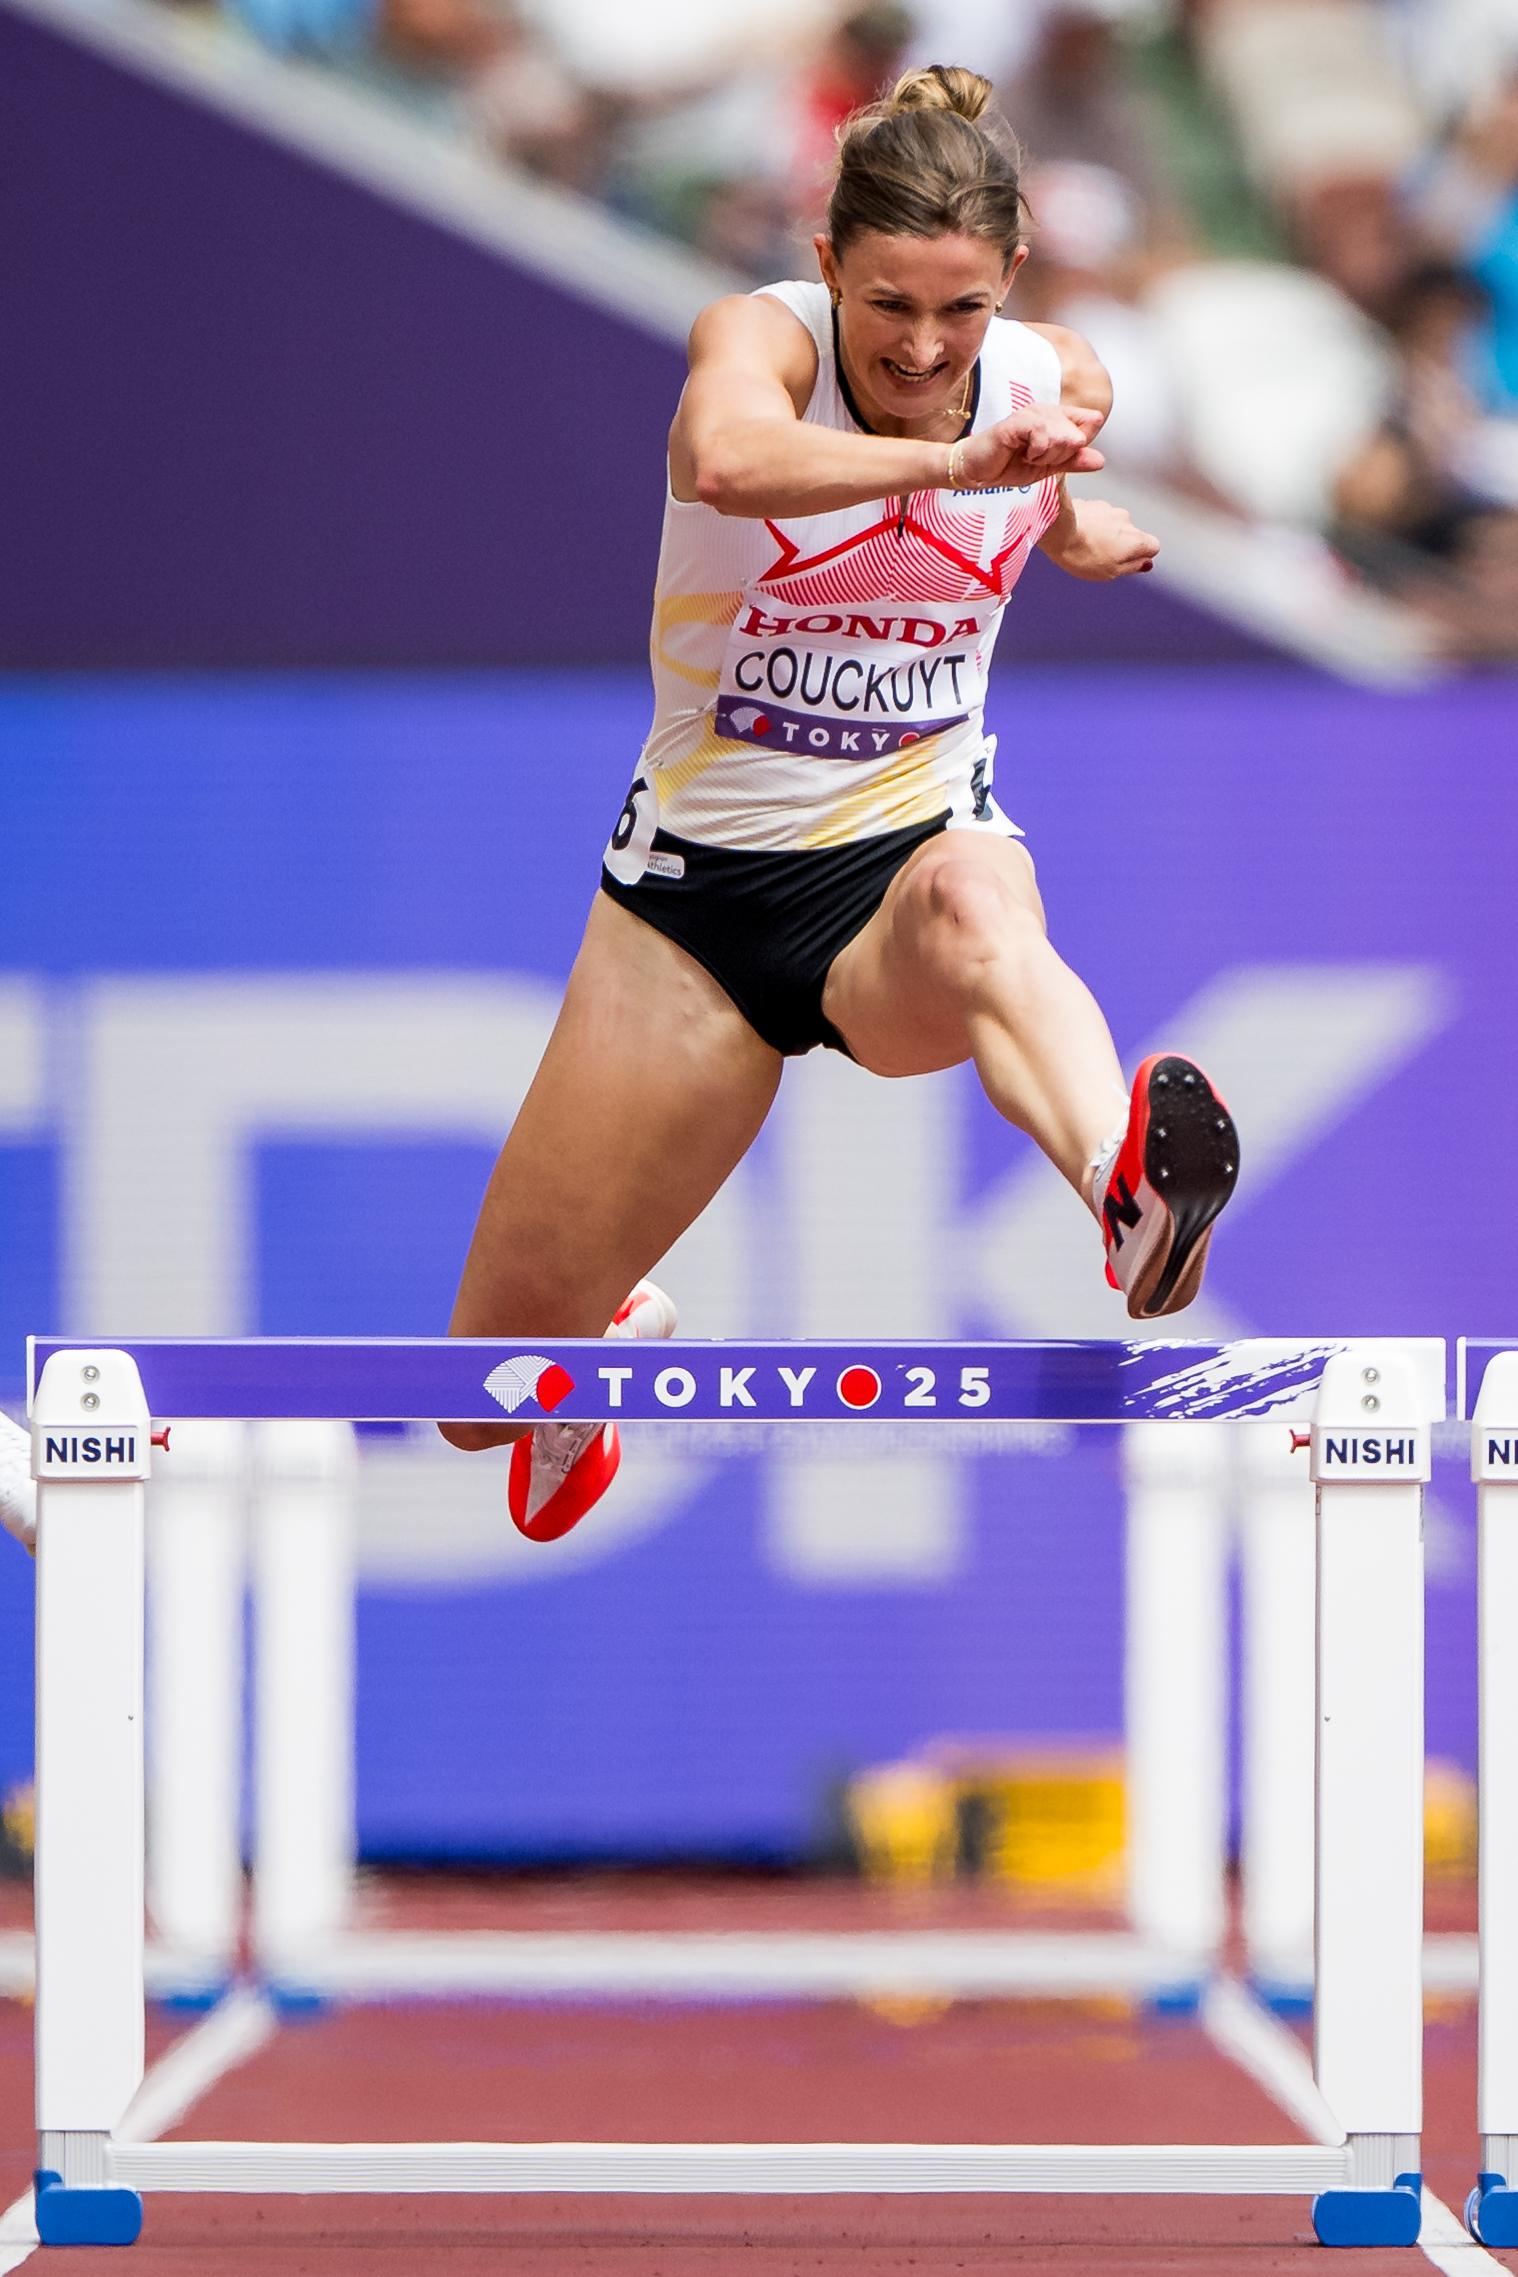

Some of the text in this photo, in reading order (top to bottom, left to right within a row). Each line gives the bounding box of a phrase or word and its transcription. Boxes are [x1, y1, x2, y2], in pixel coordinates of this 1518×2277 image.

[738, 604, 980, 648] HONDA
[735, 646, 966, 711] COUCKUYT
[612, 777, 648, 851] 6
[0, 965, 1470, 1590] DK
[46, 1437, 135, 1463] NISHI
[1326, 1438, 1415, 1464] NISHI
